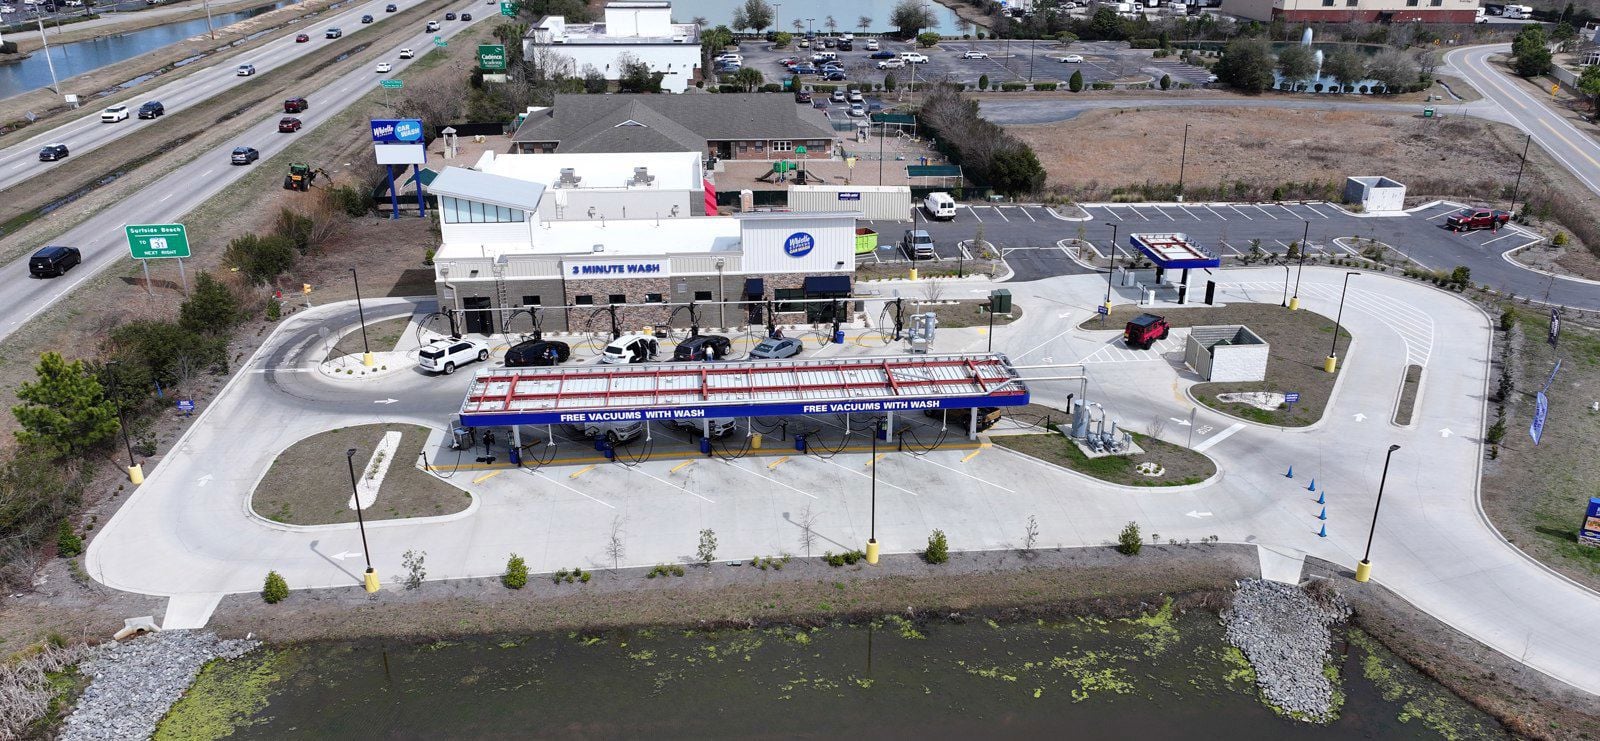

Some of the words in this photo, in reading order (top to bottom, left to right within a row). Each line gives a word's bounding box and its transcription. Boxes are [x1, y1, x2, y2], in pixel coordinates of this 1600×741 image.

[397, 124, 410, 132] CAR
[401, 128, 419, 137] WASH
[572, 266, 580, 275] 3
[582, 264, 625, 274] MINUTE
[627, 263, 660, 273] WASH
[803, 404, 828, 413] FREE
[830, 402, 881, 412] VACUUMS
[884, 401, 908, 410] WITH
[910, 400, 940, 409] WASH
[560, 413, 586, 422] FREE
[589, 410, 642, 421] VACUUMS
[645, 410, 672, 419] WITH
[674, 409, 705, 418] WASH
